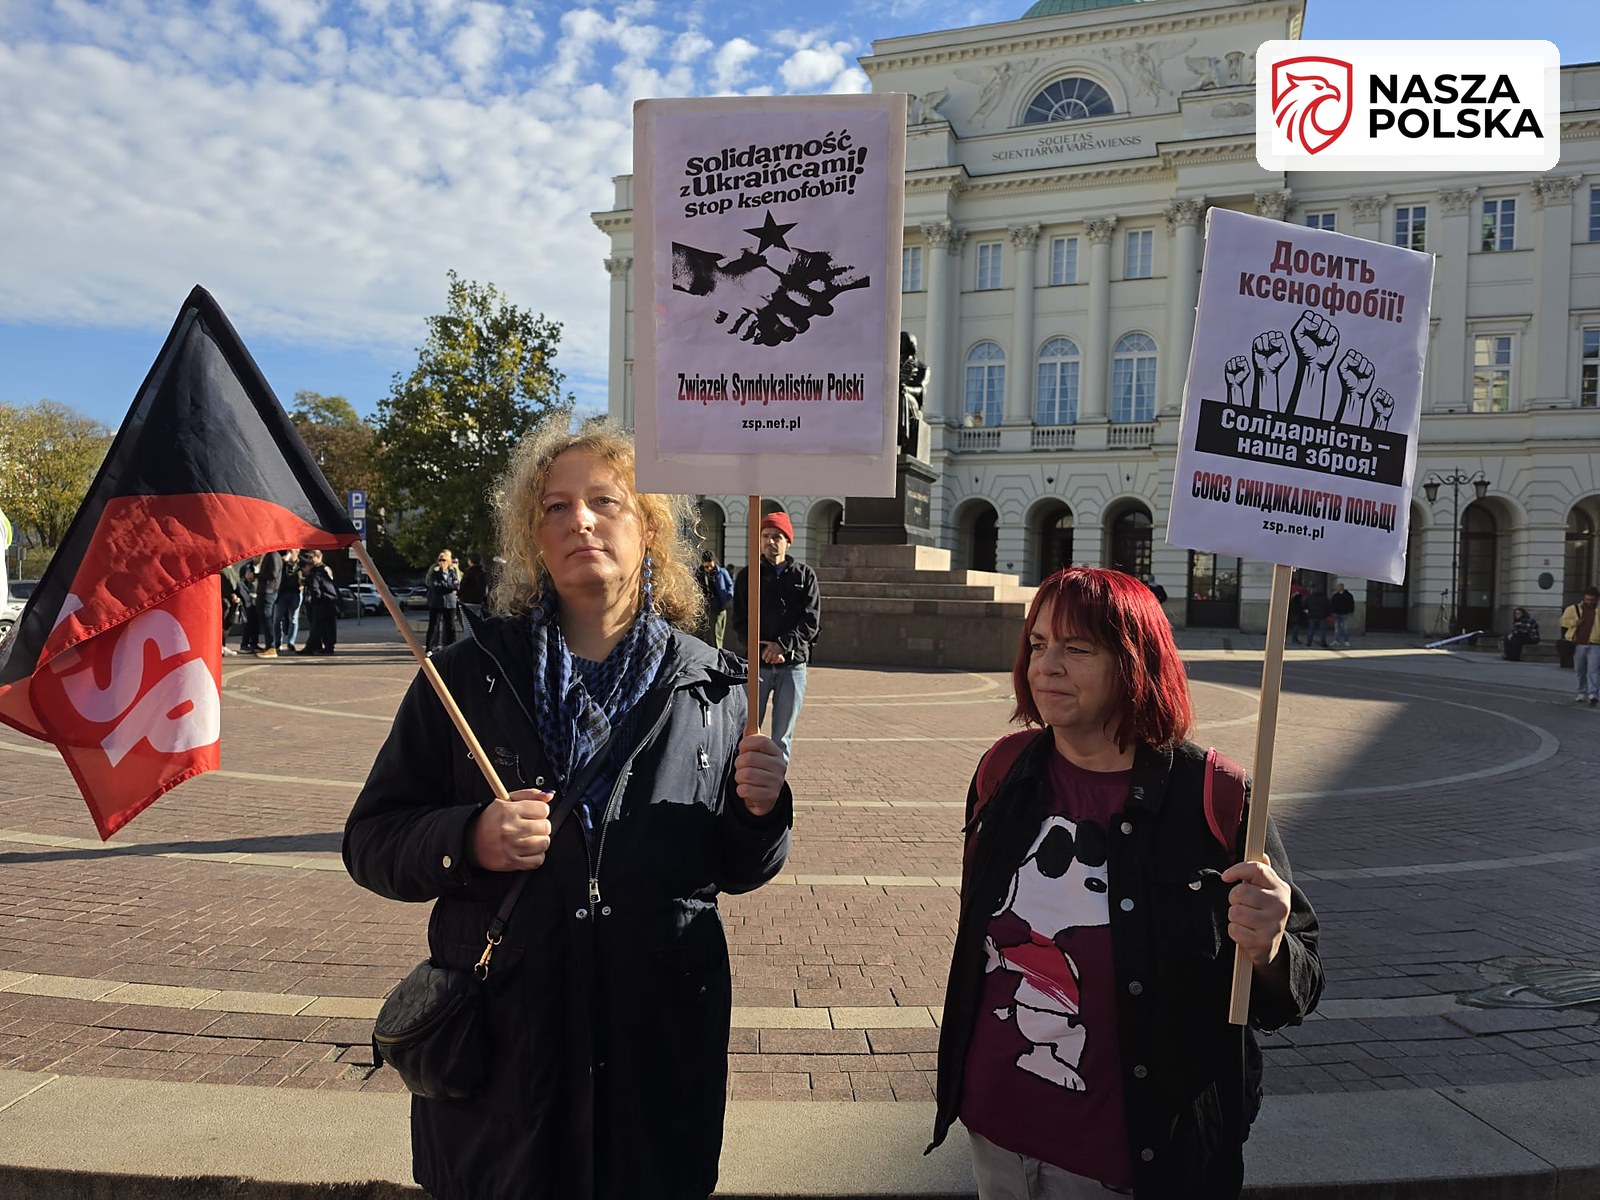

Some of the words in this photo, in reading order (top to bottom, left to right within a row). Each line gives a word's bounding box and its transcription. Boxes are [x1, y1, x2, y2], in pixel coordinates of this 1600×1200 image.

[685, 129, 853, 176] Solidarność
[1038, 132, 1093, 147] SOCIETAS
[1065, 135, 1142, 152] VARSAVIENSIS
[680, 185, 691, 197] z
[692, 146, 868, 197] Ukraińcami!
[684, 198, 733, 218] Stop
[738, 175, 856, 208] ksenofobii!
[1270, 240, 1375, 284] Досить
[1239, 271, 1405, 323] ксенофобії!
[678, 372, 728, 406] Związek
[732, 372, 824, 406] Syndykalistów
[828, 373, 864, 401] Polski
[742, 416, 801, 431] zsp.net.pl
[1220, 408, 1373, 453] Солідарність
[1237, 437, 1298, 462] наша
[1305, 448, 1378, 476] зброя!
[352, 492, 362, 507] P
[1191, 470, 1233, 503] СОЮЗ
[1235, 478, 1343, 522] СИНДИКАЛІСТІВ
[1344, 496, 1397, 534] ПОЛЬЩІ
[1262, 519, 1325, 540] zsp.net.pl
